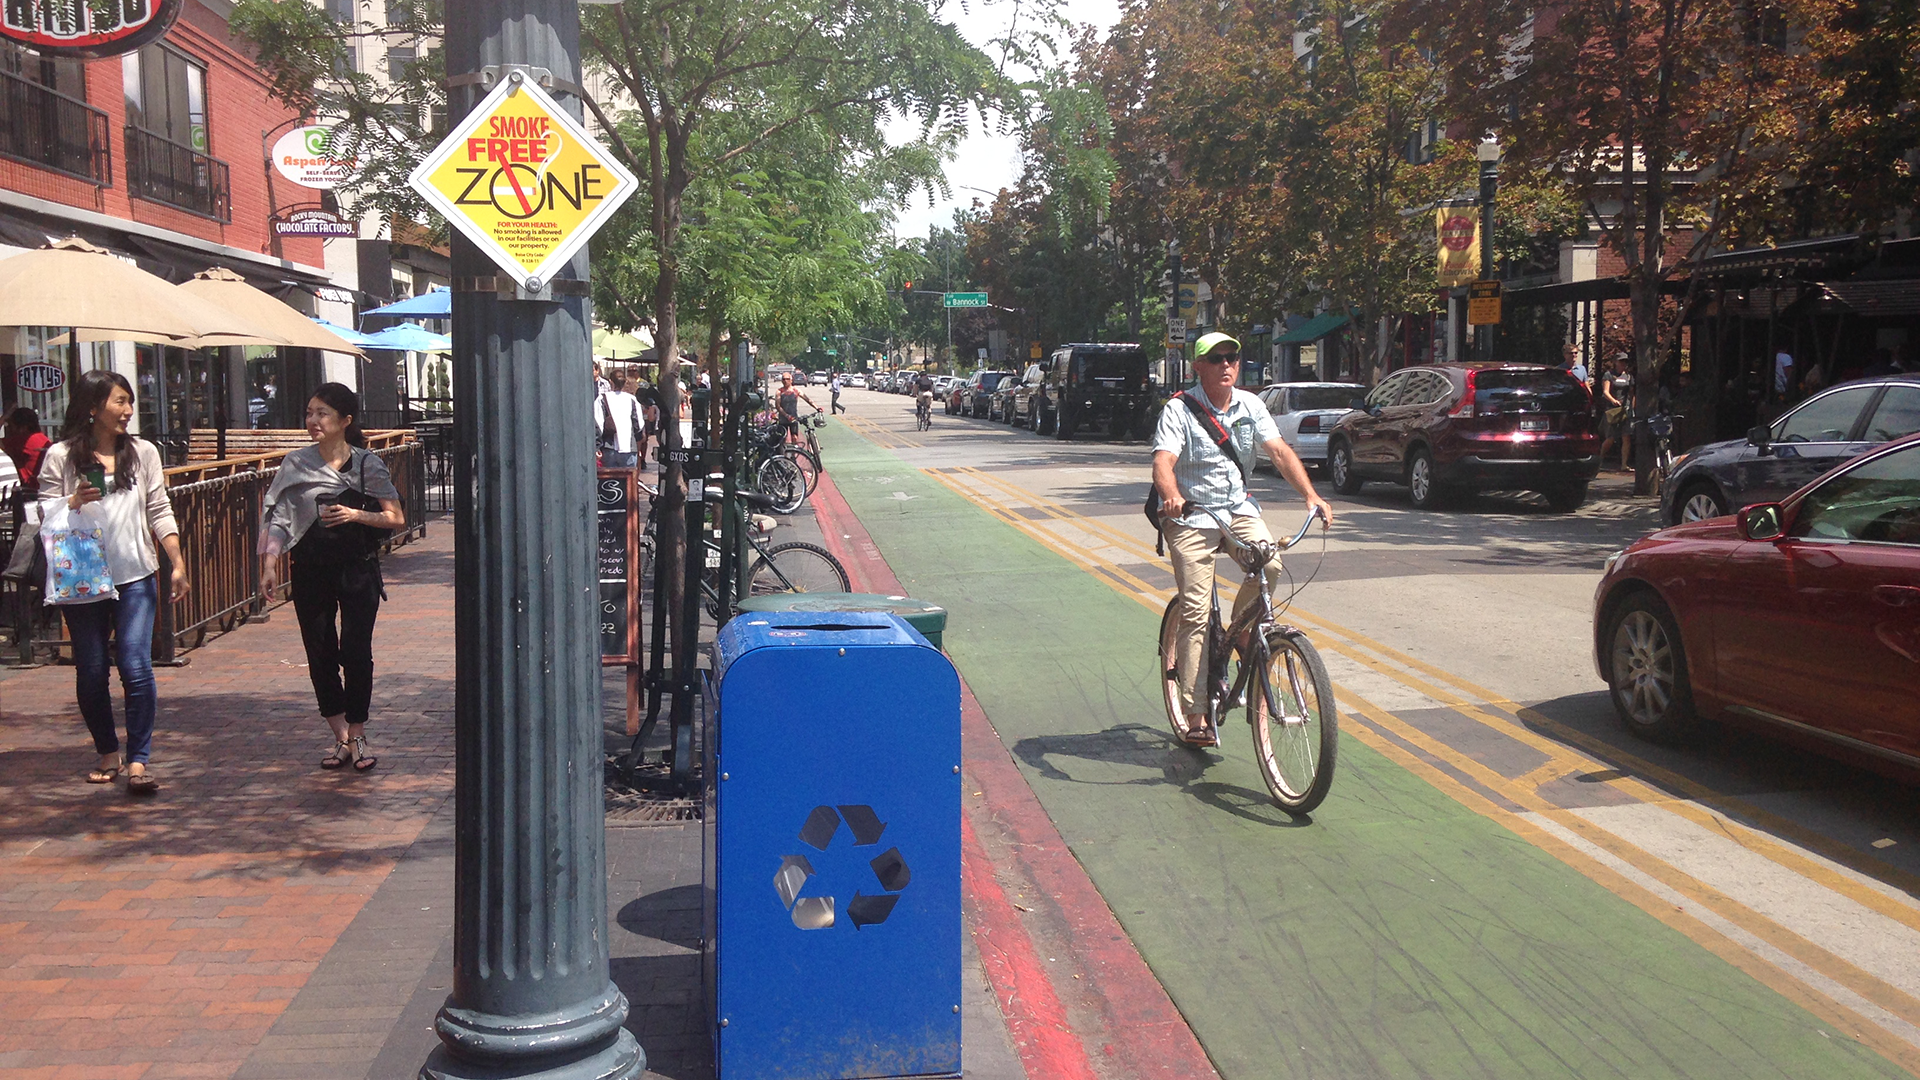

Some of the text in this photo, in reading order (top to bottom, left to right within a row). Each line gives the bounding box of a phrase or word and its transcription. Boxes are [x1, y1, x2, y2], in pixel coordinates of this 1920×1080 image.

[490, 116, 550, 138] SMOKE
[467, 138, 548, 163] FREE
[283, 155, 326, 168] Aspen
[454, 163, 603, 219] ZONE
[291, 211, 337, 223] ROCKY MOUNTAIN
[276, 222, 318, 233] CHOCOLATE
[952, 298, 979, 306] Bannock
